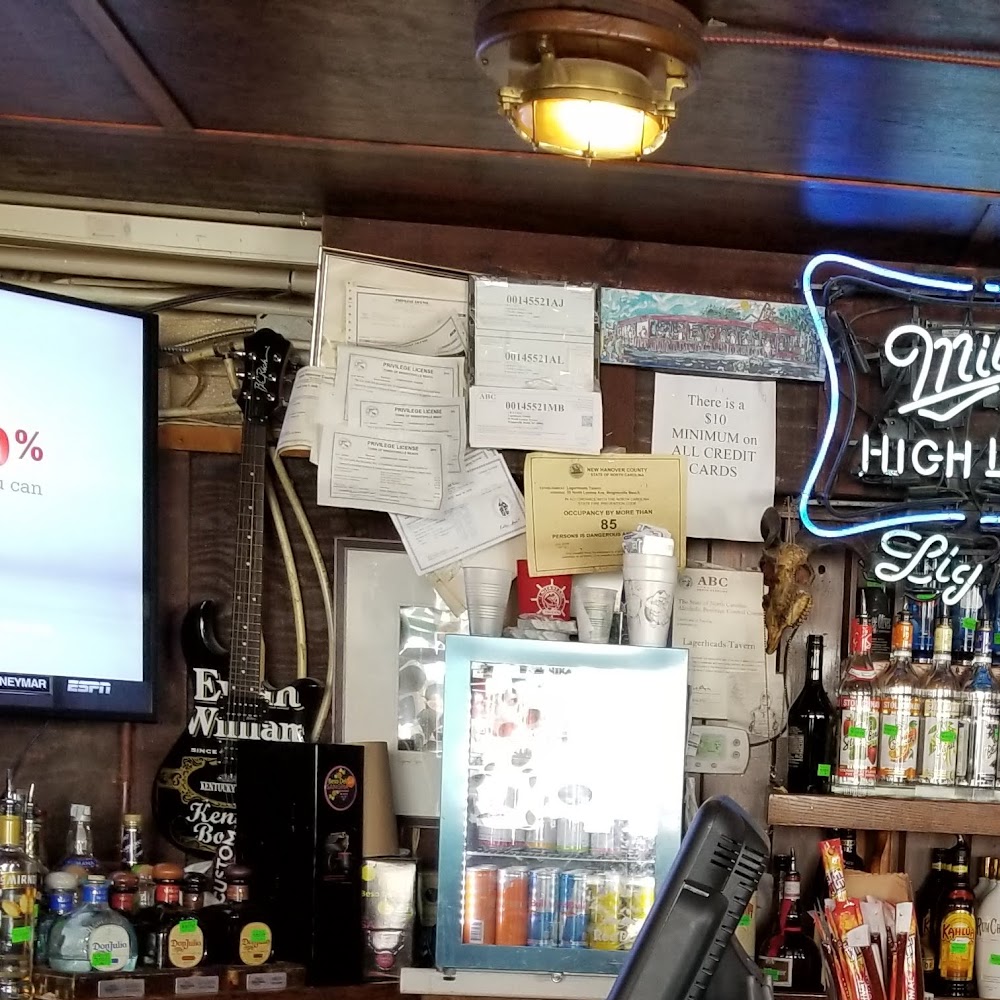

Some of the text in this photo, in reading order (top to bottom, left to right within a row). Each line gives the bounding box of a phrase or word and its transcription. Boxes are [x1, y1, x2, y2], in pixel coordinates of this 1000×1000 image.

[507, 295, 564, 307] 00145521AJ
[505, 352, 564, 364] 00145521AL
[383, 362, 410, 372] PRIVILEGE
[412, 366, 434, 374] LICENSE
[506, 402, 564, 411] 00145521MB
[688, 395, 744, 410] There is a
[705, 413, 726, 425] $10
[672, 428, 757, 445] MINIMUM on
[368, 441, 395, 449] PRIVILEGE
[672, 445, 756, 461] ALL CREDIT
[859, 434, 971, 479] HIGH
[689, 463, 737, 477] CARDS
[11, 481, 43, 495] can
[601, 519, 617, 529] 85
[698, 576, 728, 587] ABC
[683, 638, 755, 649] Lagerheads Tavern
[67, 680, 111, 694] ESPN
[200, 781, 236, 793] KENTUCKY
